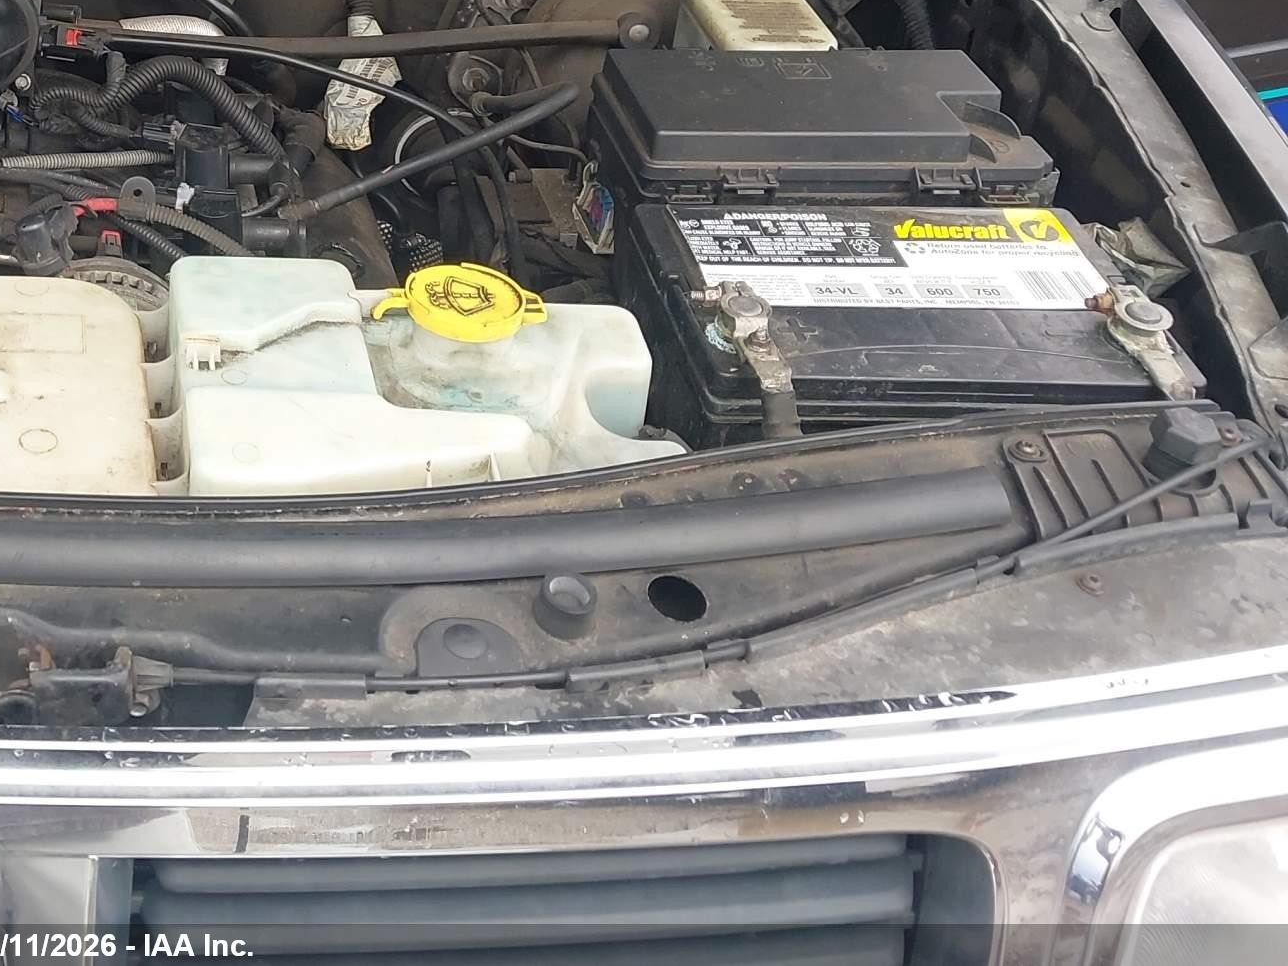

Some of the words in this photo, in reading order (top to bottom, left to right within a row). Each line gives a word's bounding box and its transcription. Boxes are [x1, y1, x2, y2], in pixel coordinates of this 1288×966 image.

[893, 218, 1011, 240] Valucraft
[814, 286, 860, 295] 34-VL
[884, 286, 904, 295] 34
[925, 287, 953, 296] 600
[972, 287, 1001, 296] 750
